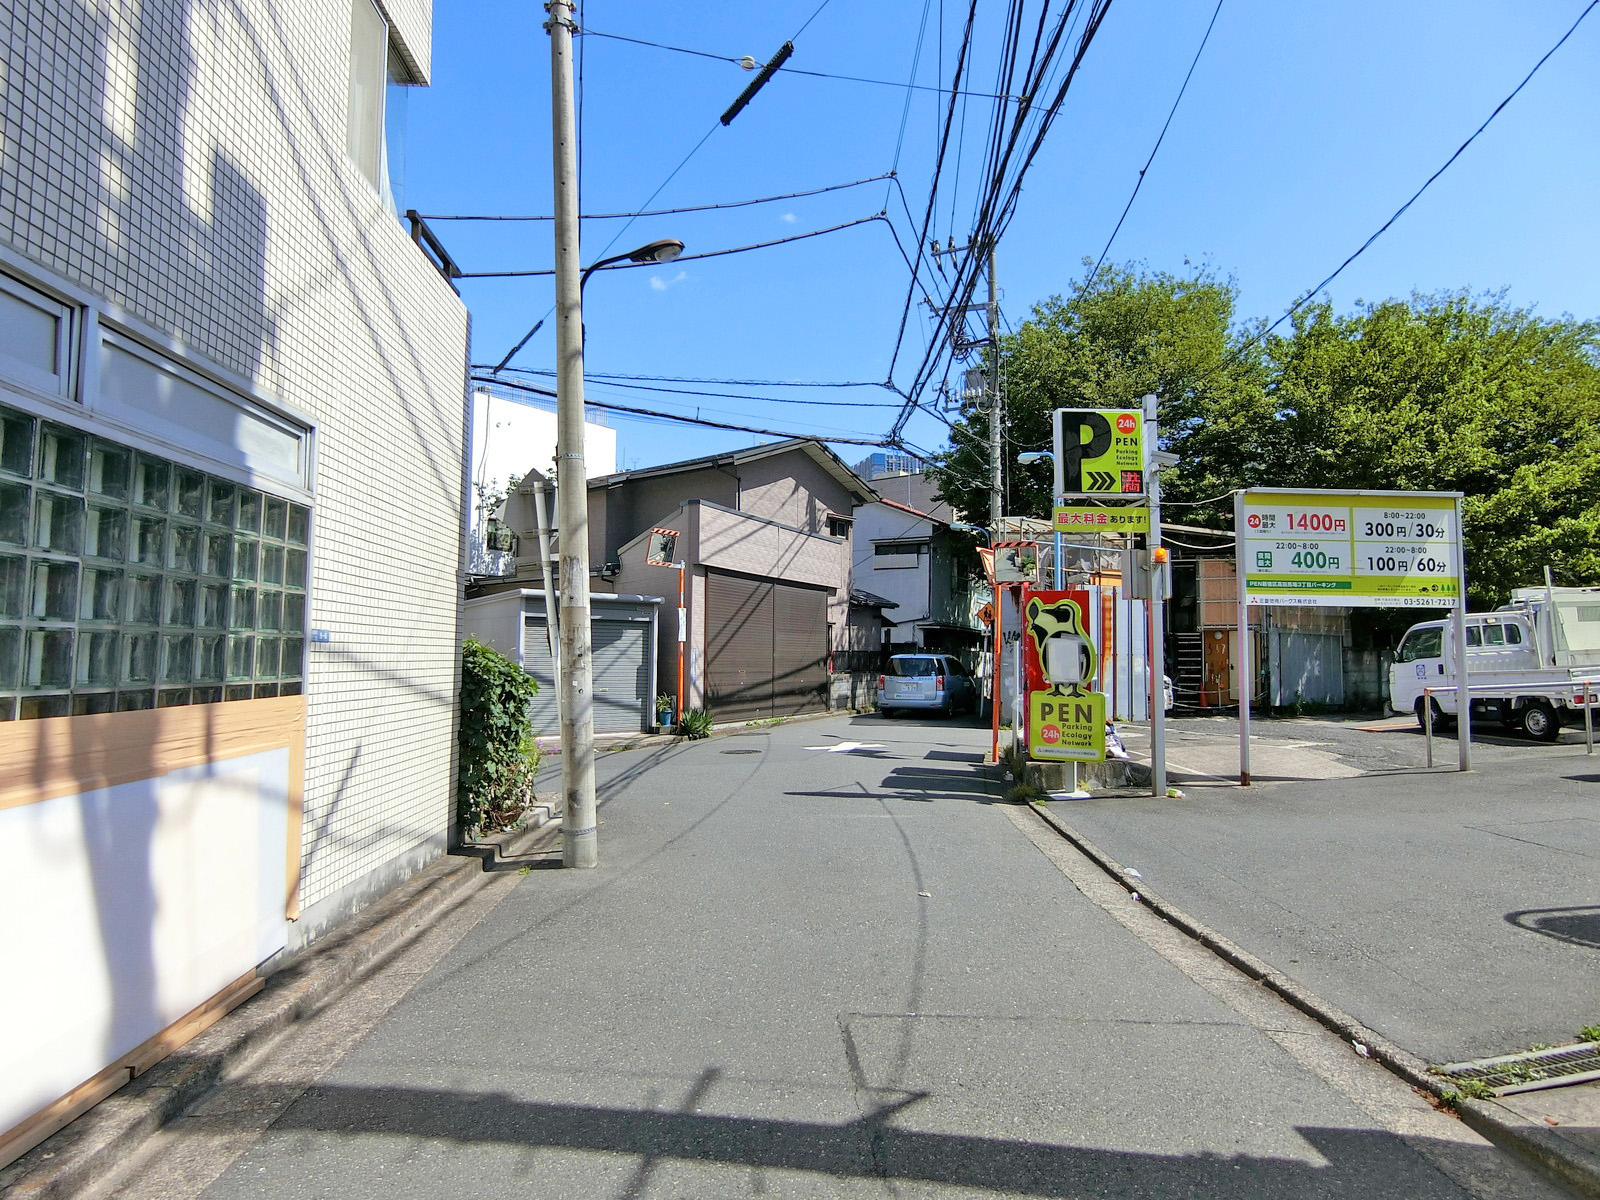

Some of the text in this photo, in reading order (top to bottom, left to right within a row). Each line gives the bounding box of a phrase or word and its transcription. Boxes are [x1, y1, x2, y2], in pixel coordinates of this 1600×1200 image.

[1117, 419, 1136, 429] 24h
[1115, 437, 1138, 446] PEN
[1062, 412, 1112, 493] P
[1249, 517, 1260, 525] 24
[1261, 521, 1276, 529] 最大
[1403, 598, 1456, 606] 03-5261-7217
[1040, 702, 1092, 723] PEN
[1061, 722, 1093, 731] Parking
[1042, 729, 1060, 739] 24h
[1061, 731, 1093, 740] Ecology
